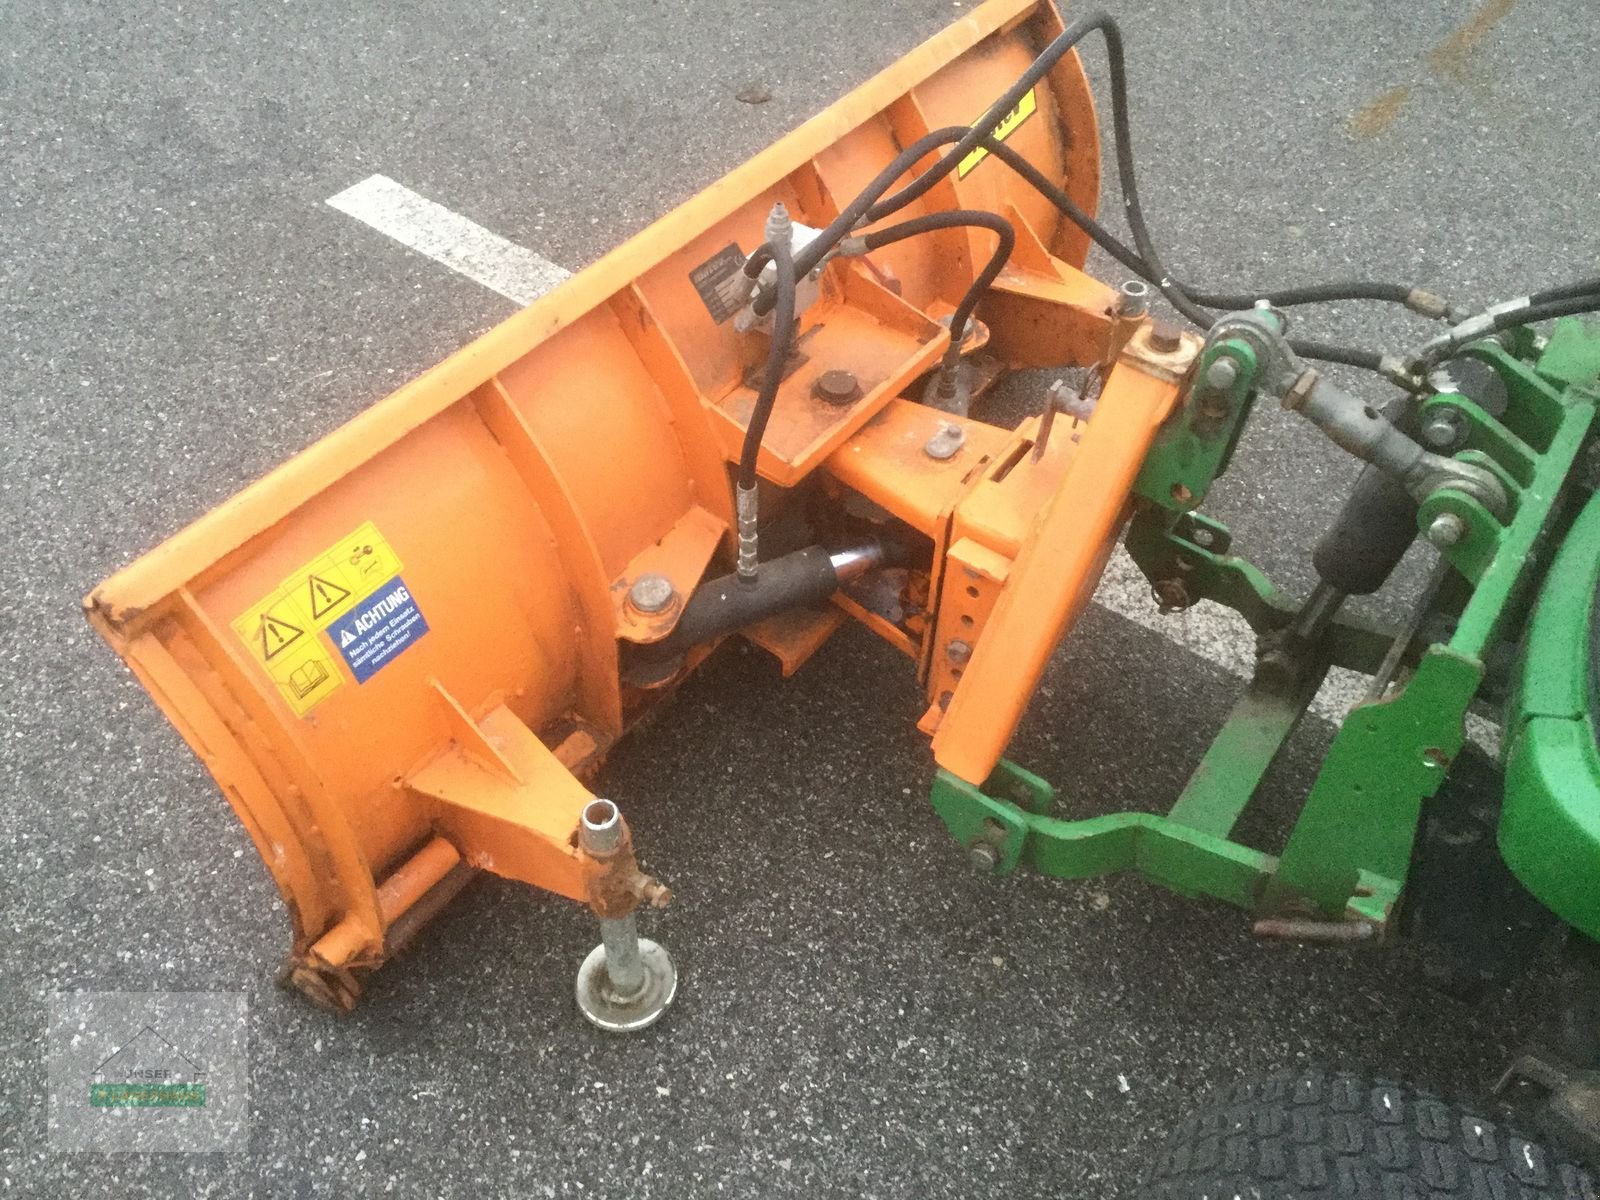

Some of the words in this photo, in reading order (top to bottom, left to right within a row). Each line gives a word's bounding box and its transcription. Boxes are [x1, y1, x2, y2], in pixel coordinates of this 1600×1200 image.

[349, 640, 369, 658] Nach
[368, 625, 390, 647] jedem
[389, 606, 415, 627] Einsatz
[354, 586, 410, 635] ACHTUNG
[352, 641, 385, 668] sämtliche
[385, 613, 421, 642] Schrauben
[371, 630, 411, 665] nachziehen!
